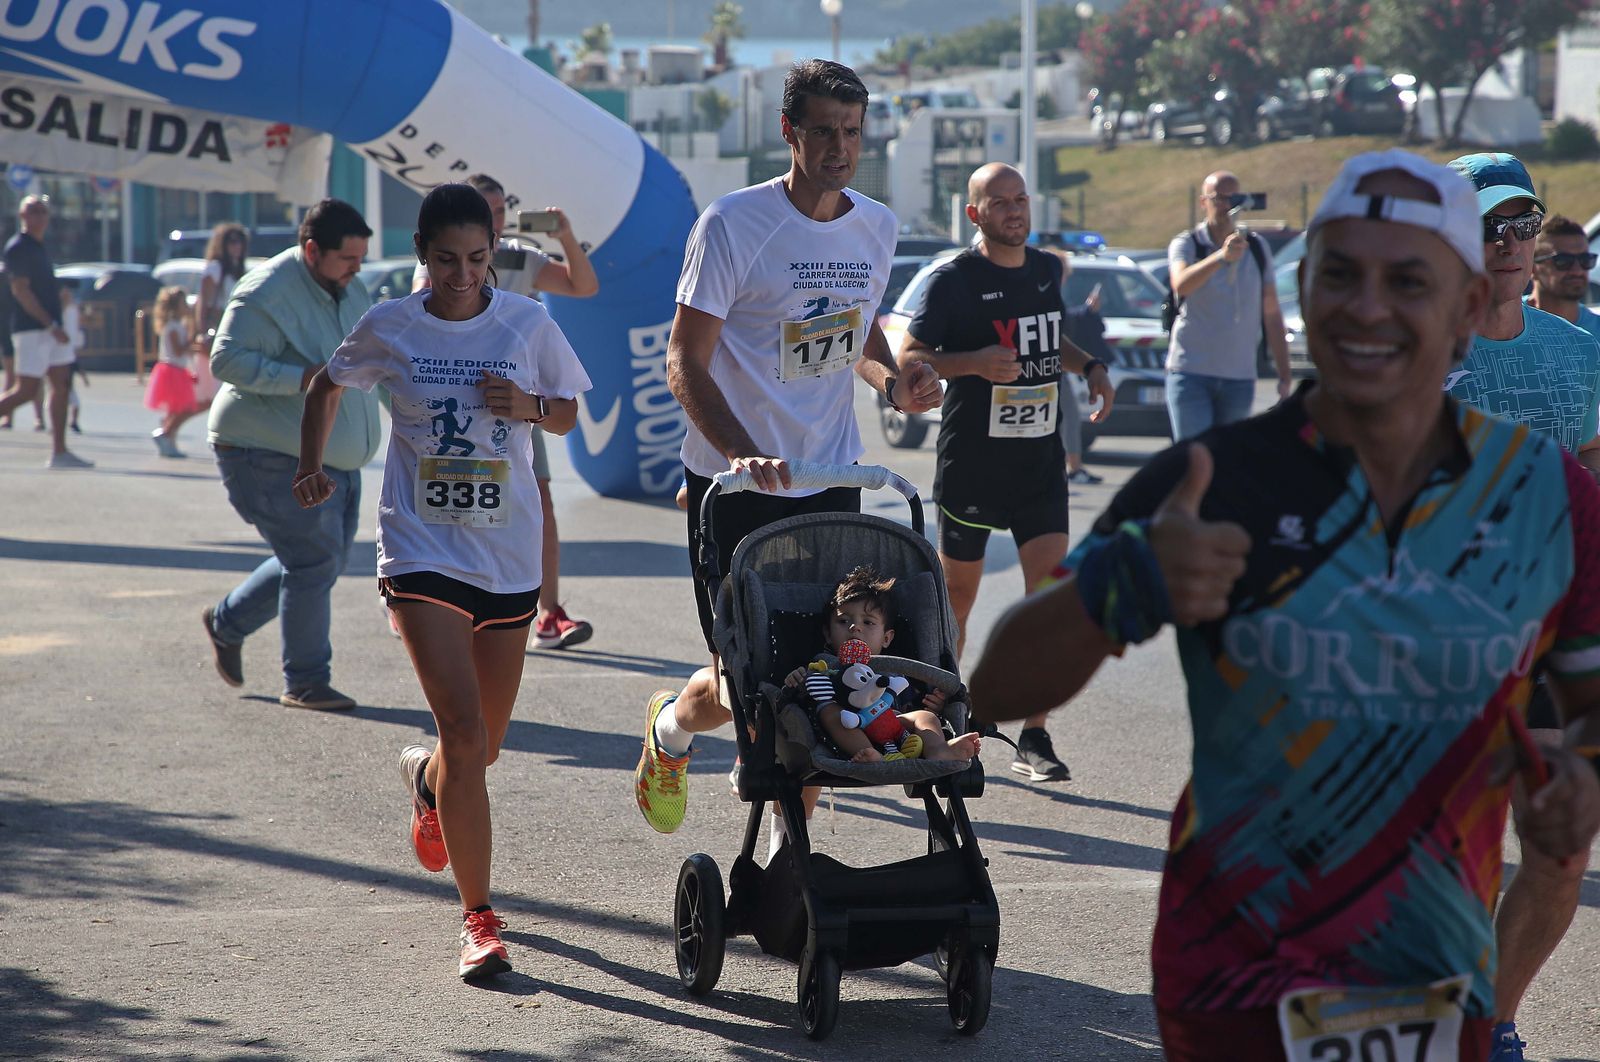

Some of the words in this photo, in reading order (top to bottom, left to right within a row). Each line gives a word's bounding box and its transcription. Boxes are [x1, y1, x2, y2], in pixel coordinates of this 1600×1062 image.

[0, 86, 231, 163] SALIDA
[790, 262, 823, 270] XXIII
[798, 271, 837, 279] CARRERA
[838, 271, 870, 279] URBANA
[793, 282, 823, 290] CIUDAD
[824, 281, 834, 289] DE
[992, 310, 1063, 357] XFIT
[792, 330, 854, 364] 171
[410, 356, 448, 366] XXIII
[453, 359, 517, 371] EDICIÓN
[418, 365, 465, 377] CARRERA
[412, 375, 446, 385] CIUDAD
[448, 377, 460, 386] DE
[999, 403, 1050, 425] 221
[426, 480, 500, 509] 338
[1222, 613, 1542, 697] CORRUCO
[1299, 699, 1391, 721] TRAIL
[1398, 702, 1485, 721] TEAM
